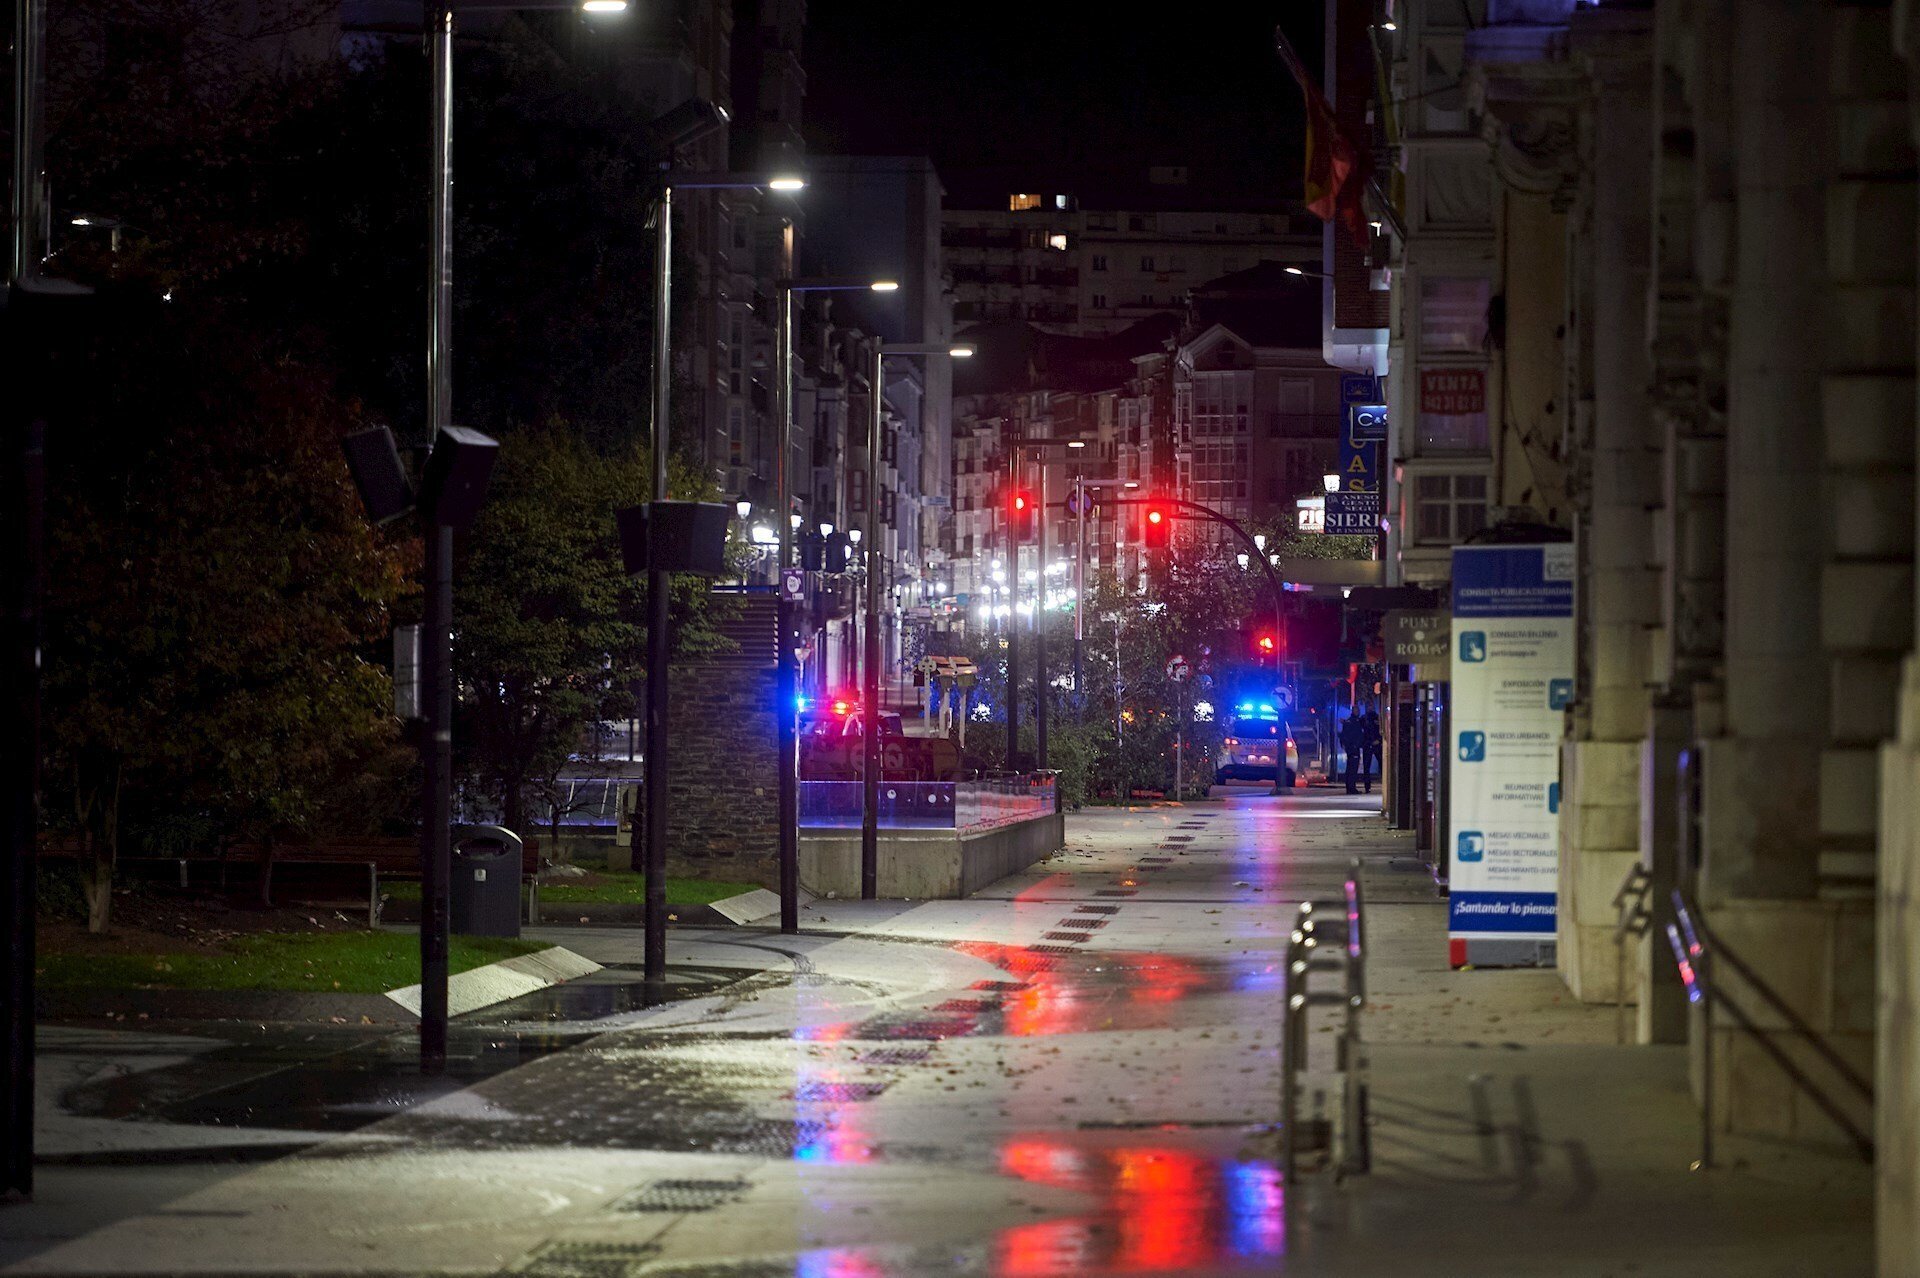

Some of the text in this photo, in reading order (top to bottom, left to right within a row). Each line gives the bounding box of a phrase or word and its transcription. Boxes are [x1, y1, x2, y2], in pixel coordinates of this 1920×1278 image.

[1426, 376, 1480, 391] VENTA
[1400, 616, 1440, 629] PUNT
[1396, 643, 1442, 655] ROMA
[1504, 783, 1545, 791] REUNIONES
[1492, 793, 1545, 801] INFORMATIVAS
[1454, 901, 1510, 915] ¡Santander
[1511, 902, 1521, 913] lo
